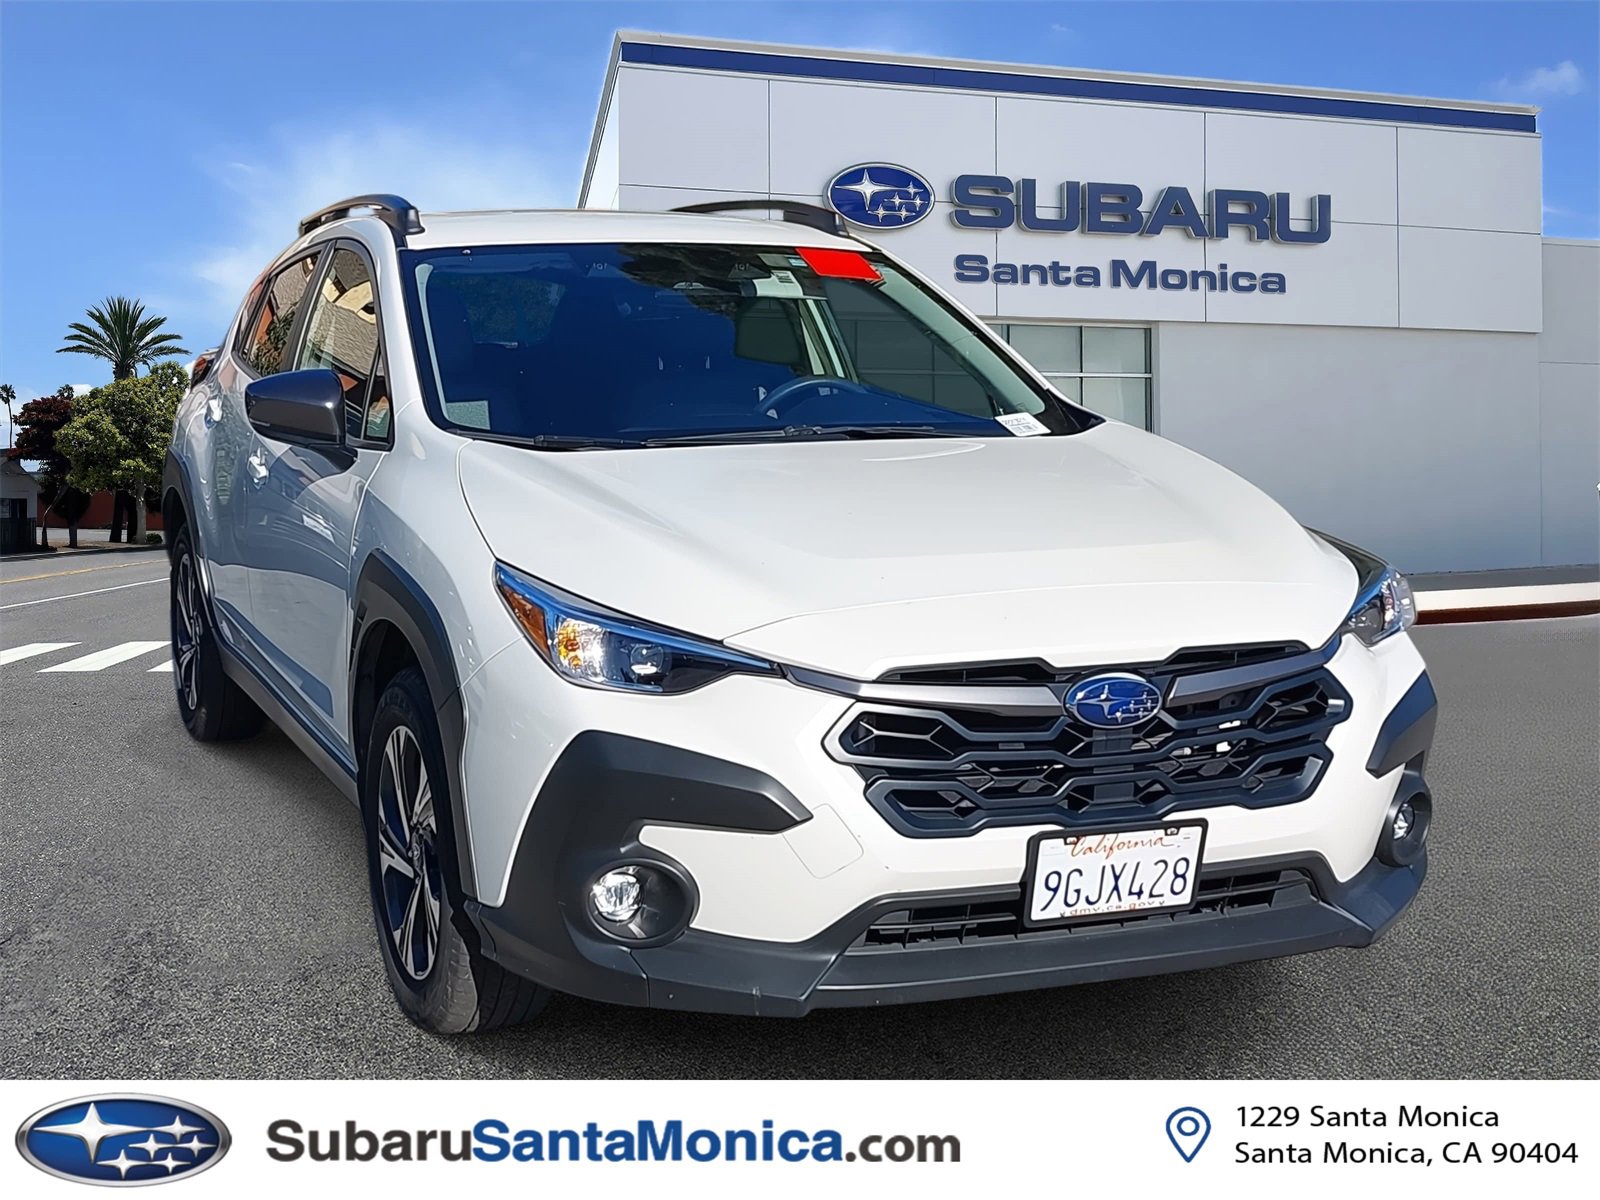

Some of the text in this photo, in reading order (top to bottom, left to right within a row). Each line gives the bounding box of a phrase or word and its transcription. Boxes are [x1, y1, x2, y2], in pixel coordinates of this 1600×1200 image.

[950, 174, 1332, 244] SUBARU
[954, 253, 1287, 295] Santa Monica
[1071, 833, 1173, 859] California
[1040, 857, 1190, 912] 9GJX428
[1069, 900, 1156, 916] dmv.ca.gov
